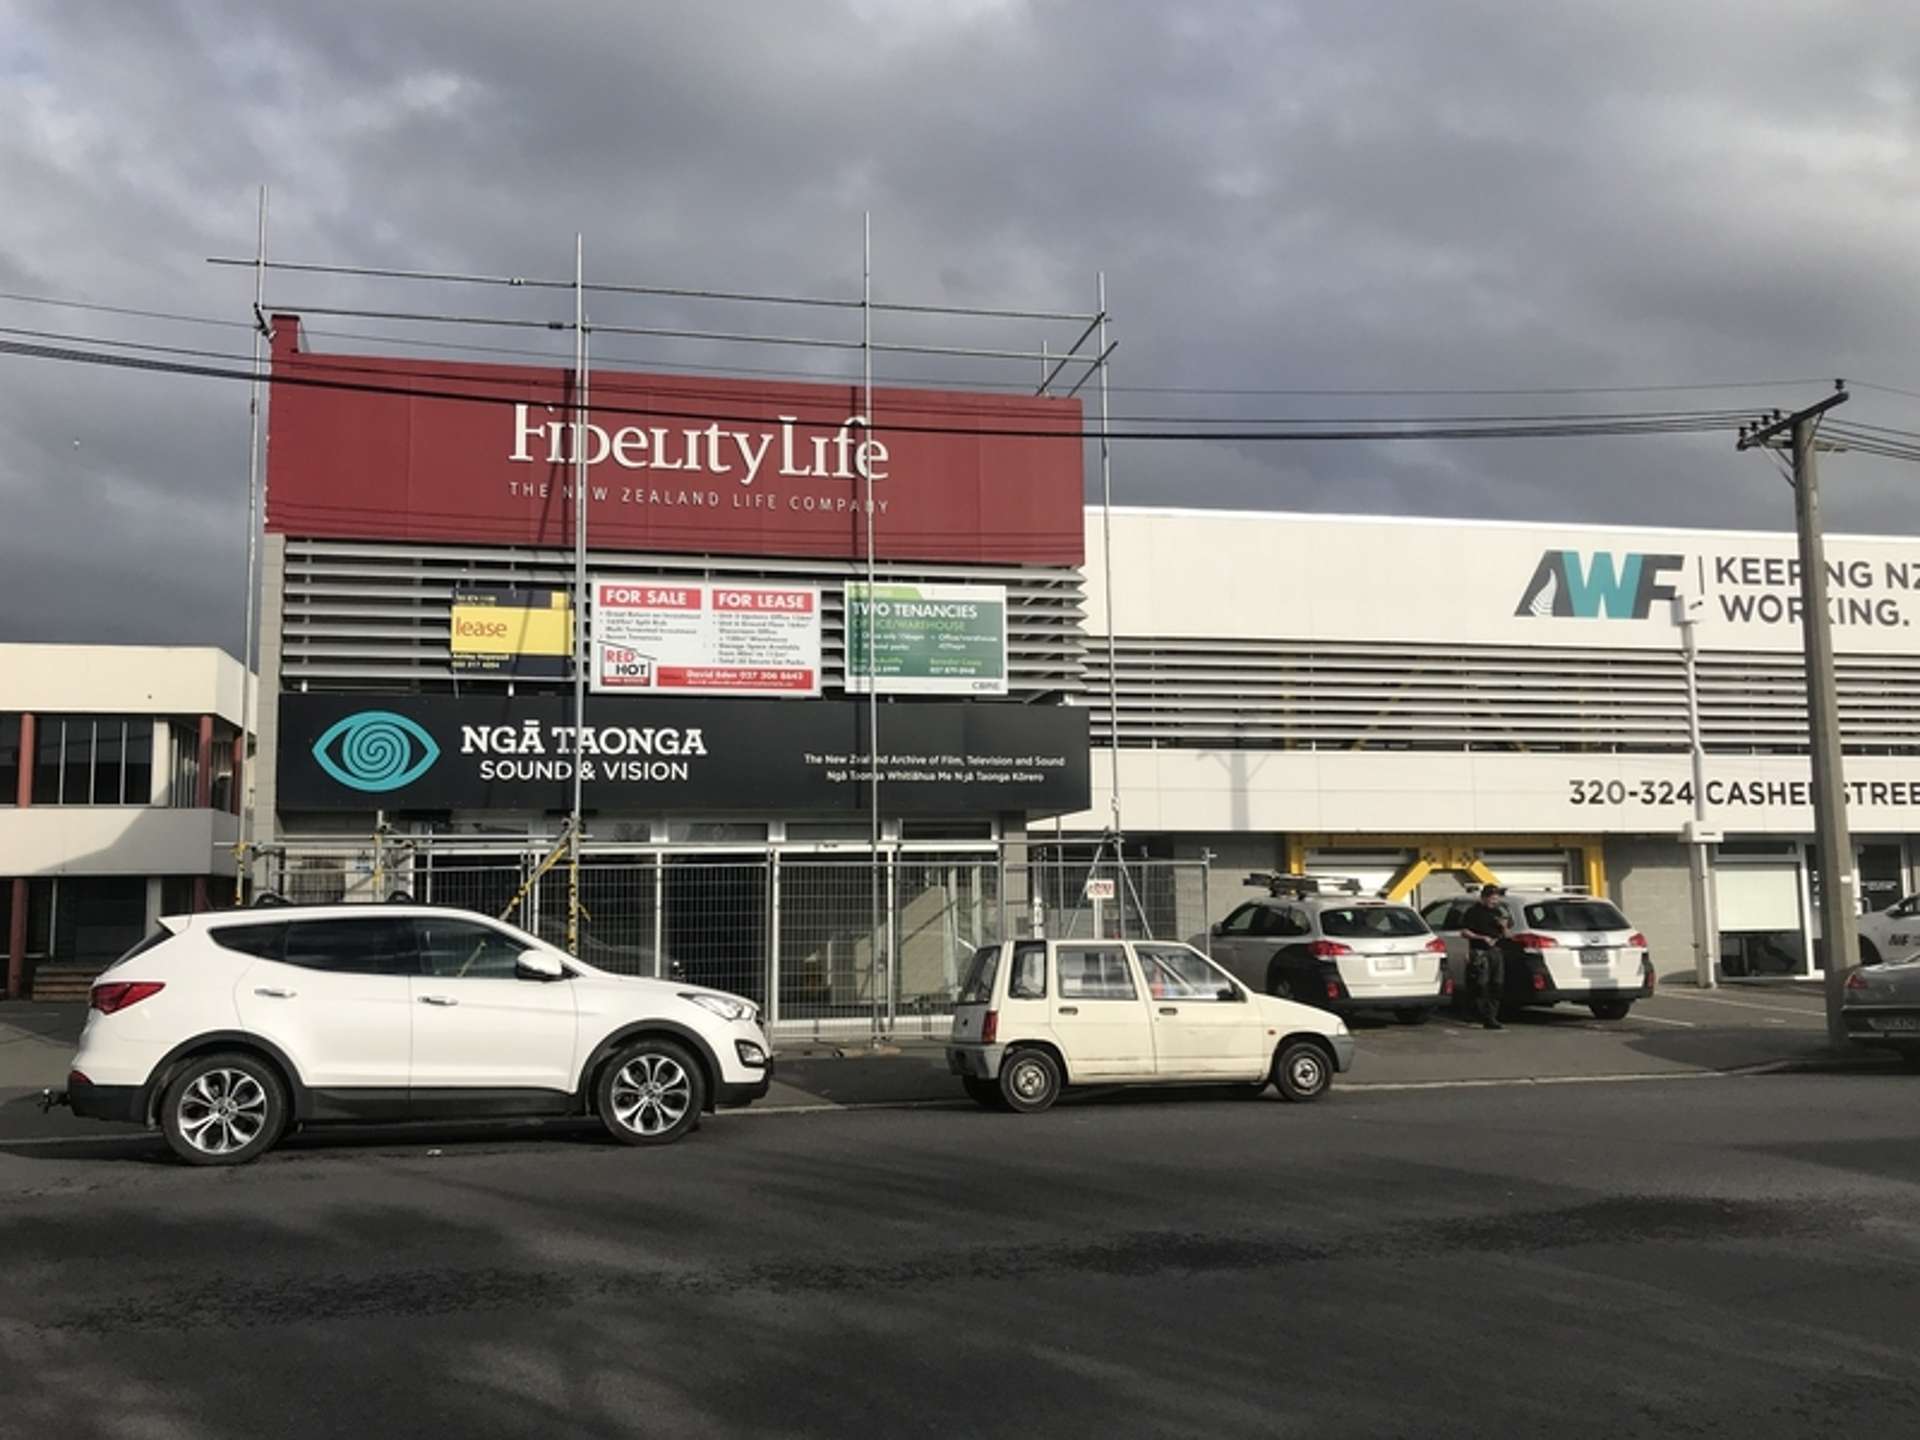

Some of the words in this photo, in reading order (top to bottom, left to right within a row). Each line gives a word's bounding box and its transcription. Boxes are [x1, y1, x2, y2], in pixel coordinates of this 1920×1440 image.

[509, 481, 548, 498] THE
[563, 485, 609, 501] NW
[621, 487, 720, 506] ZEALAND
[733, 494, 777, 510] LIFE
[1514, 549, 1686, 620] AWF
[1715, 556, 1873, 589] KEEPNG
[606, 588, 641, 604] FOR
[647, 590, 687, 606] SALE
[718, 592, 753, 607] FOR
[757, 594, 805, 609] LEASE
[893, 603, 978, 619] TENANCIES
[455, 616, 508, 638] lease
[606, 649, 634, 663] RED
[616, 664, 646, 676] HOT
[461, 719, 546, 755] NGĀ
[551, 726, 708, 756] TAONGA
[803, 753, 823, 765] The
[825, 754, 847, 765] New
[890, 755, 927, 766] Archive
[929, 755, 939, 765] of
[966, 755, 1014, 767] Television
[1015, 757, 1033, 767] and
[1035, 756, 1066, 768] Sound
[480, 760, 573, 781] SOUND
[579, 760, 597, 781] &
[602, 761, 689, 782] VISION
[1568, 779, 1695, 806] 320-324
